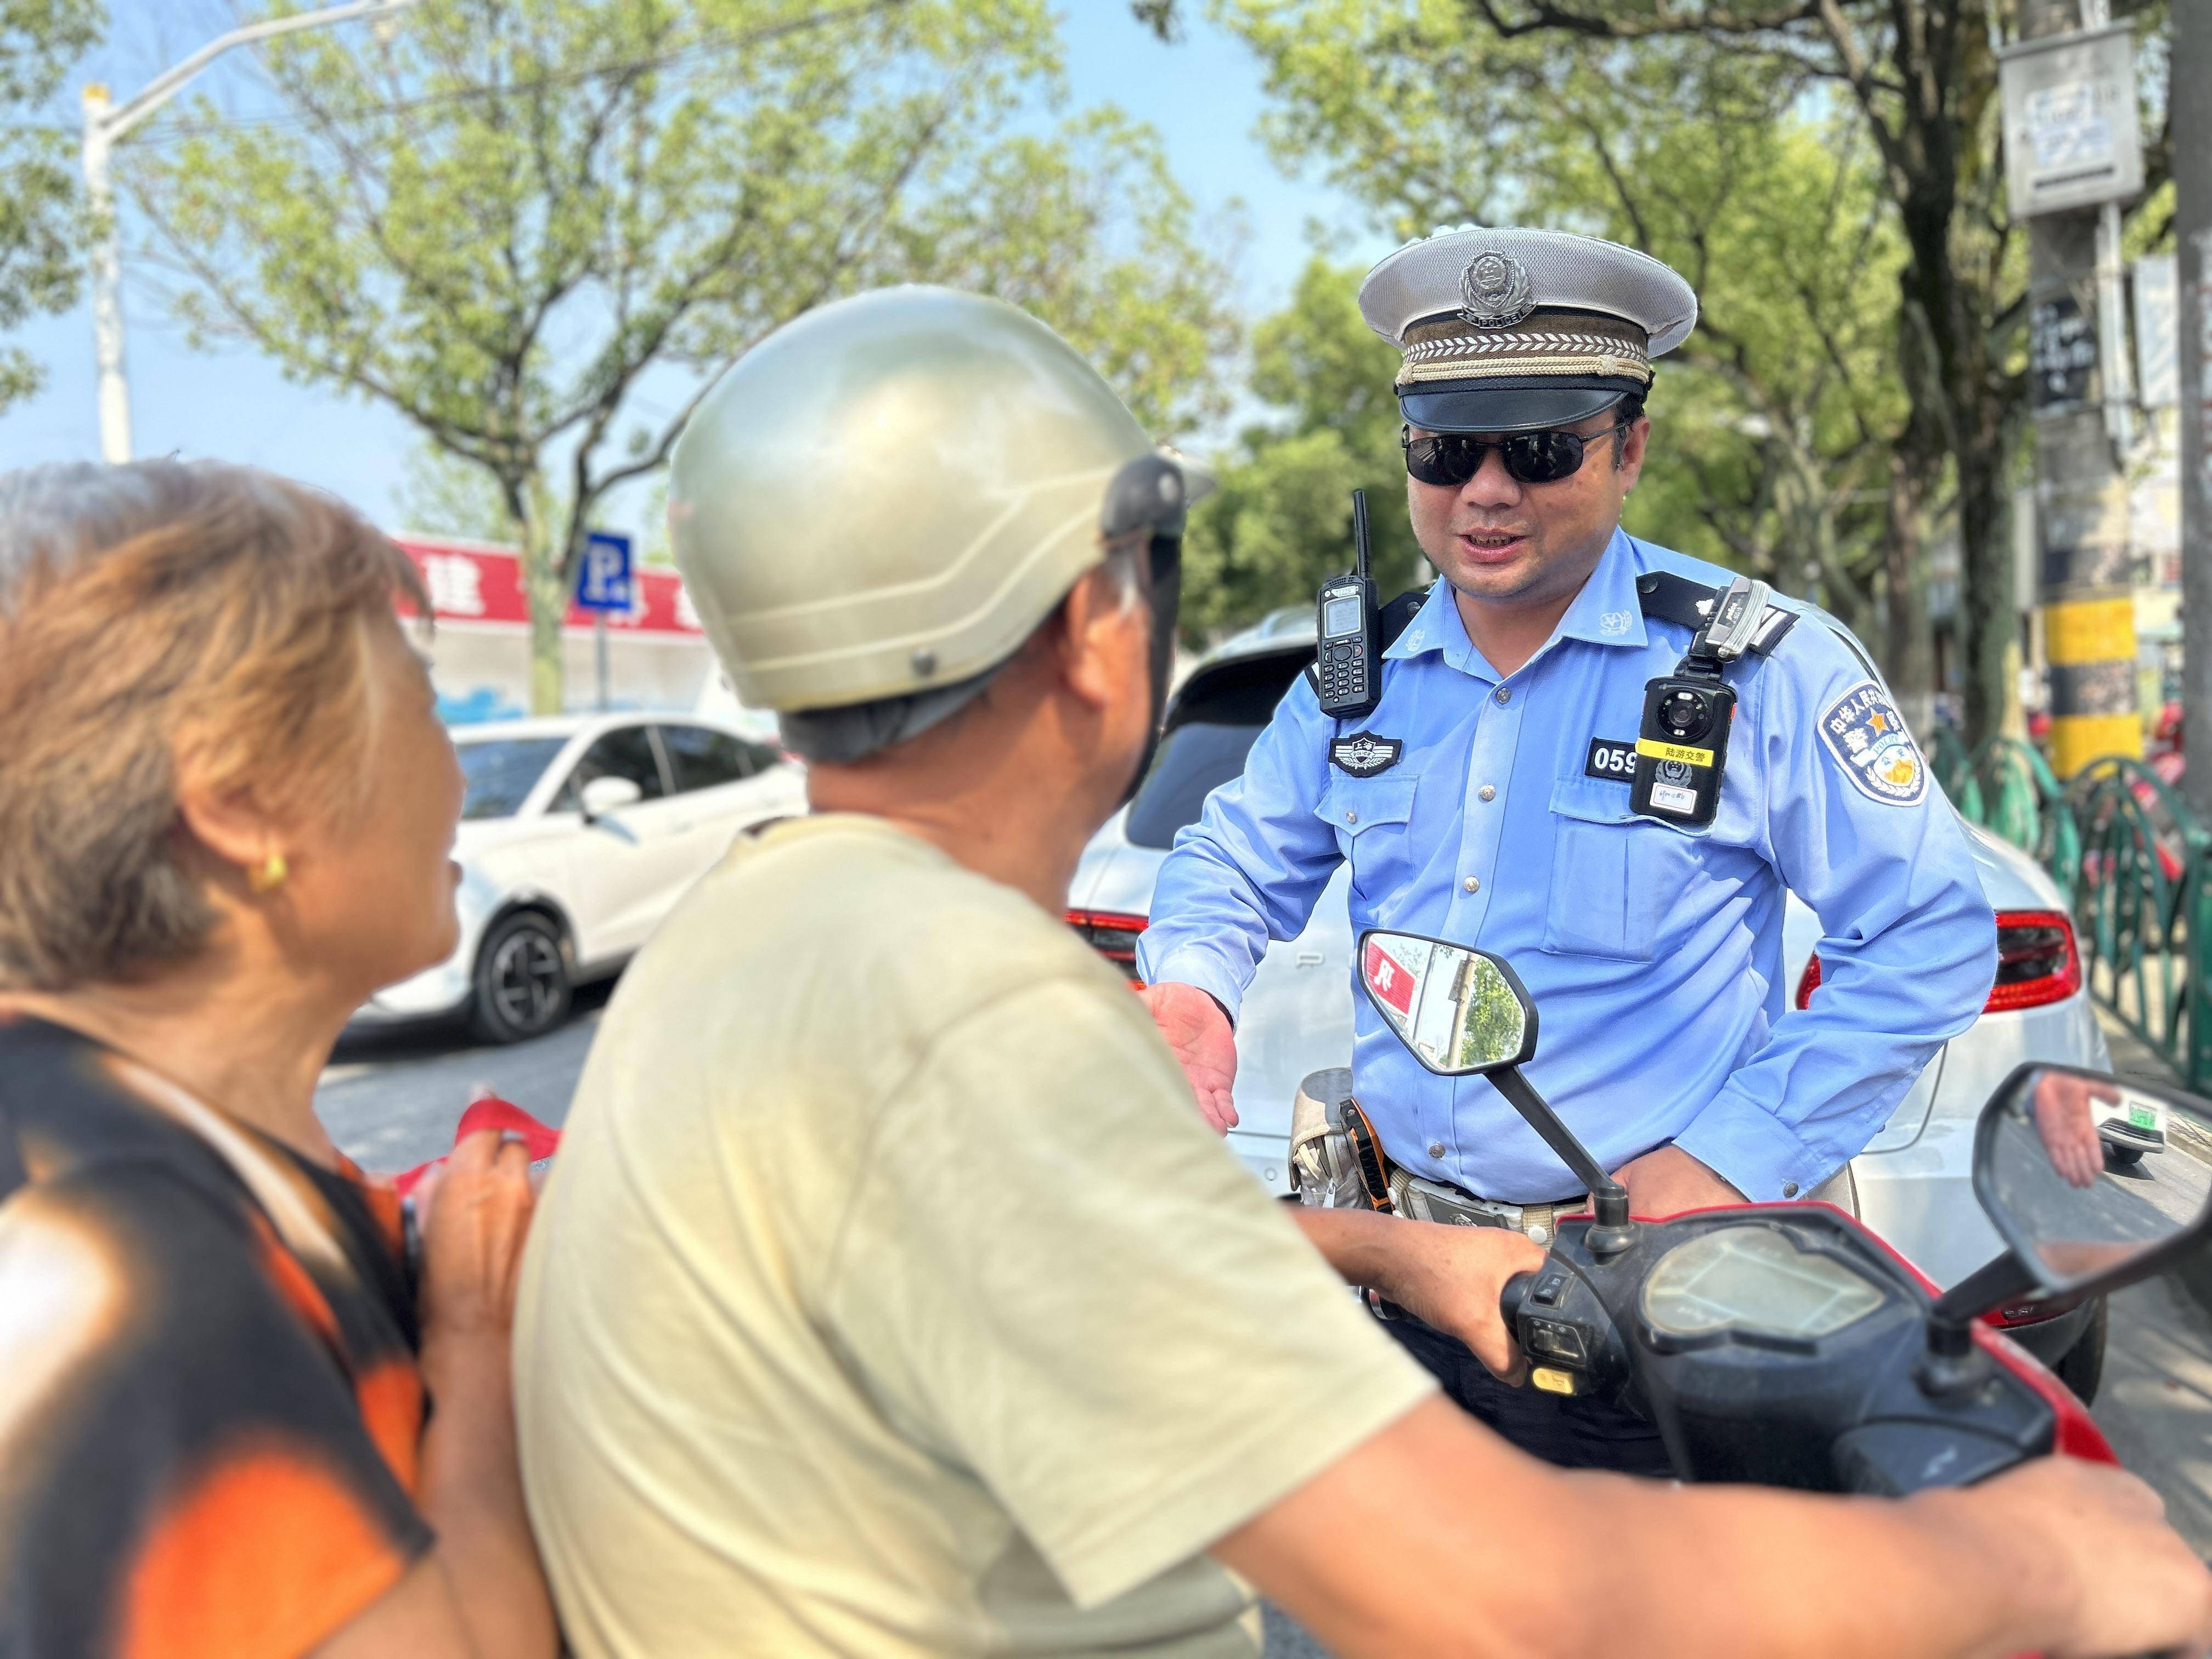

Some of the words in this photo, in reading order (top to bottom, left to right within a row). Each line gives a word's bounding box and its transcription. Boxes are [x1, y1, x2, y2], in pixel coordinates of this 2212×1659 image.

[1482, 313, 1519, 327] POLICE
[584, 544, 623, 601] P
[1830, 689, 1892, 734] 中华人民共和
[1355, 742, 1373, 751] 上海
[1873, 735, 1899, 754] POLICE
[1666, 747, 1706, 762] 陆游交警
